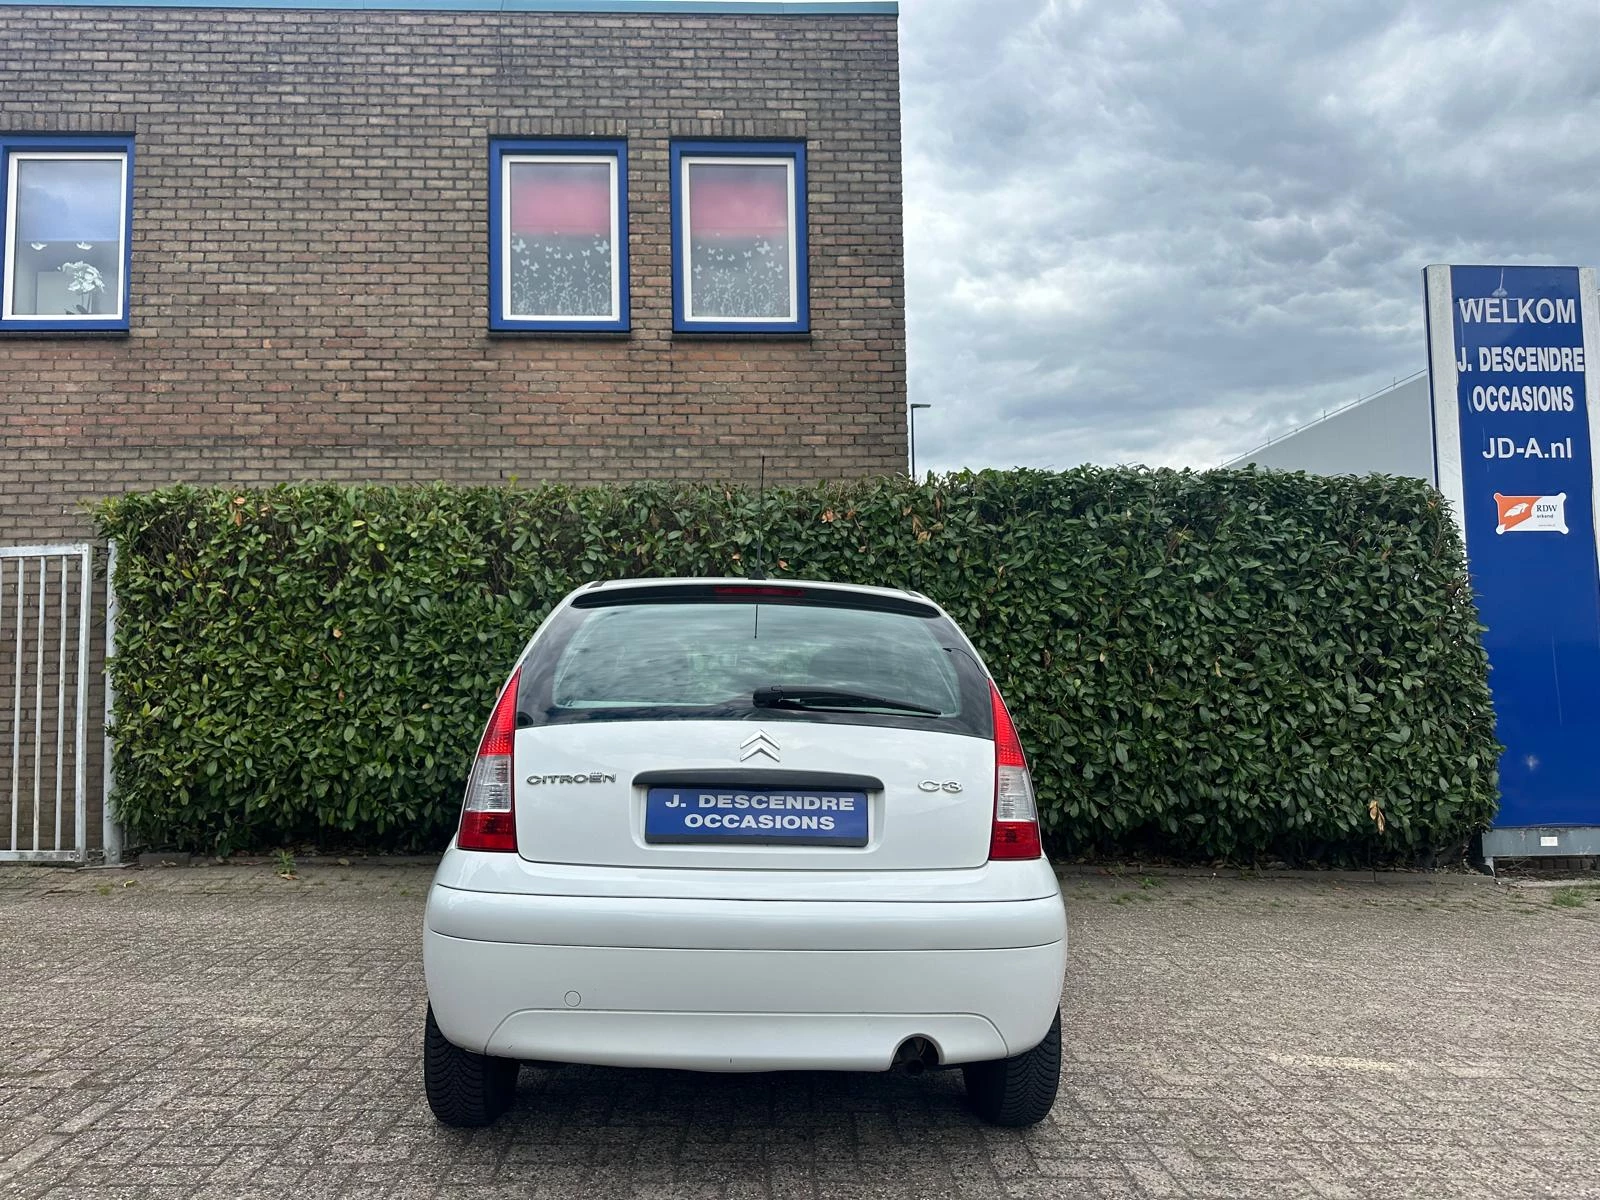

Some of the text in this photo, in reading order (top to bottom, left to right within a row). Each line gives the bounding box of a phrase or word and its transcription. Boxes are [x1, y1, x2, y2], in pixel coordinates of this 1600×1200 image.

[1459, 298, 1576, 323] WELKOM
[1457, 347, 1585, 372] J. DESCENDRE
[1473, 386, 1574, 412] OCCASIONS
[1482, 437, 1572, 458] JD-A.nl
[1536, 504, 1558, 512] RDW
[527, 772, 616, 785] CITROËN
[918, 780, 963, 794] C3
[665, 794, 855, 811] J. DESCENDRE
[684, 814, 835, 830] OCCASIONS
